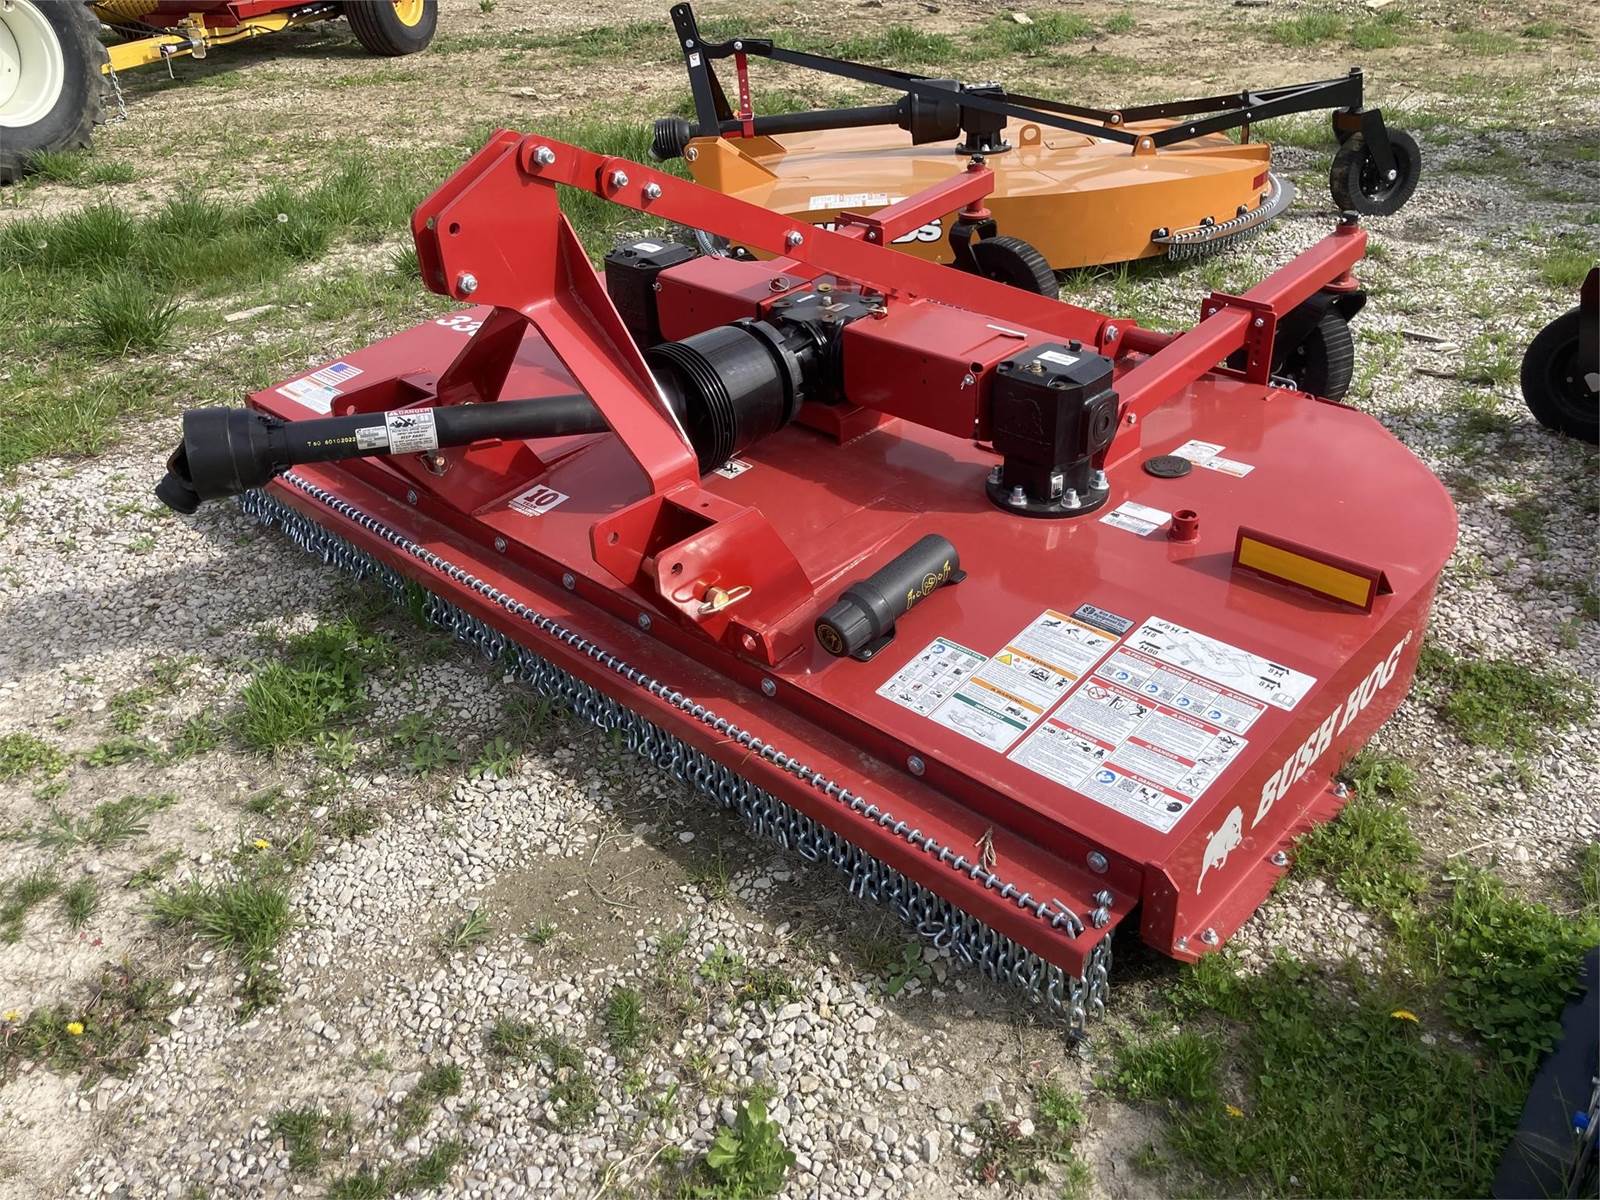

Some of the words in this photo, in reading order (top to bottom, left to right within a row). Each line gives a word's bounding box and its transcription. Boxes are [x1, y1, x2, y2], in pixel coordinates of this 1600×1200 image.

[523, 488, 559, 506] 10
[974, 703, 1006, 720] IMPORTANT
[1178, 715, 1204, 728] DANGER
[1073, 729, 1098, 744] DANGER
[1250, 703, 1343, 830] BUSH
[1336, 641, 1405, 737] HOG
[1153, 746, 1179, 760] DANGER
[1139, 776, 1165, 791] DANGER
